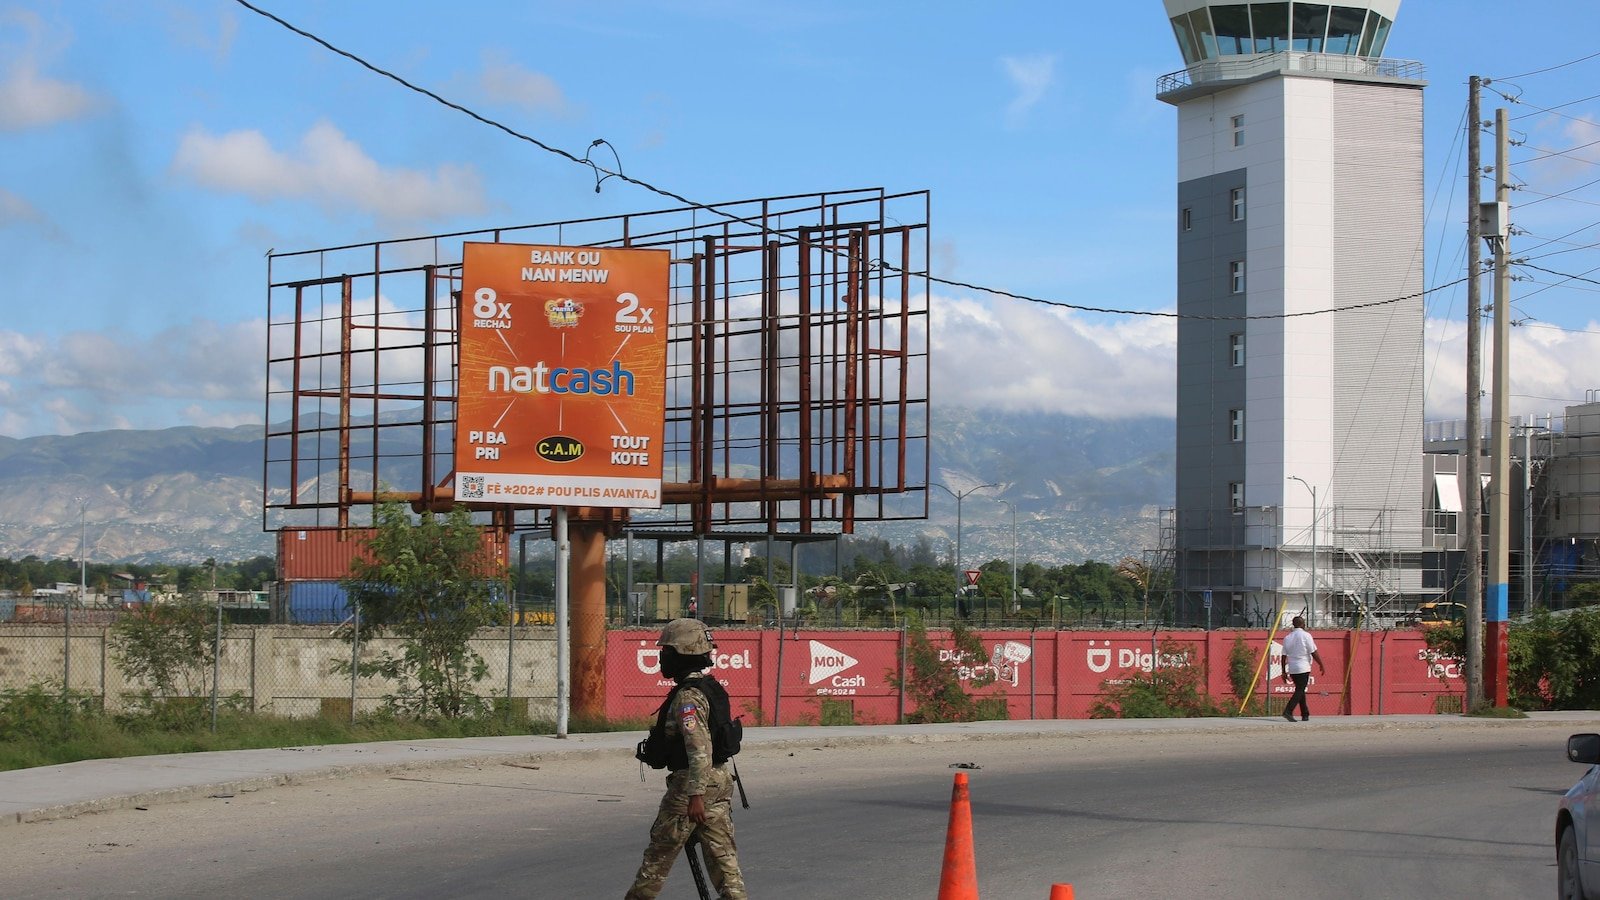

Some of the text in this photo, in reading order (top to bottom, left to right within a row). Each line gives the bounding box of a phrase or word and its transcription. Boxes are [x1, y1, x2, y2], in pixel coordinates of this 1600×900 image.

[530, 250, 601, 267] BANK OU
[521, 267, 609, 285] NAN MENW
[473, 318, 512, 329] RECHAJ
[614, 324, 655, 334] SOU PLAN
[488, 360, 635, 397] natcash
[469, 430, 507, 445] PI BA
[610, 435, 650, 450] TOUT
[475, 446, 499, 460] PRI
[538, 442, 582, 456] C.A.M
[611, 451, 649, 466] KOTE
[487, 482, 501, 494] FÈ
[547, 485, 572, 497] POU
[574, 486, 600, 498] PLIS
[602, 487, 657, 500] AVANTAJ
[814, 656, 845, 667] MON
[656, 679, 678, 687] Ansa
[831, 674, 866, 687] Cash
